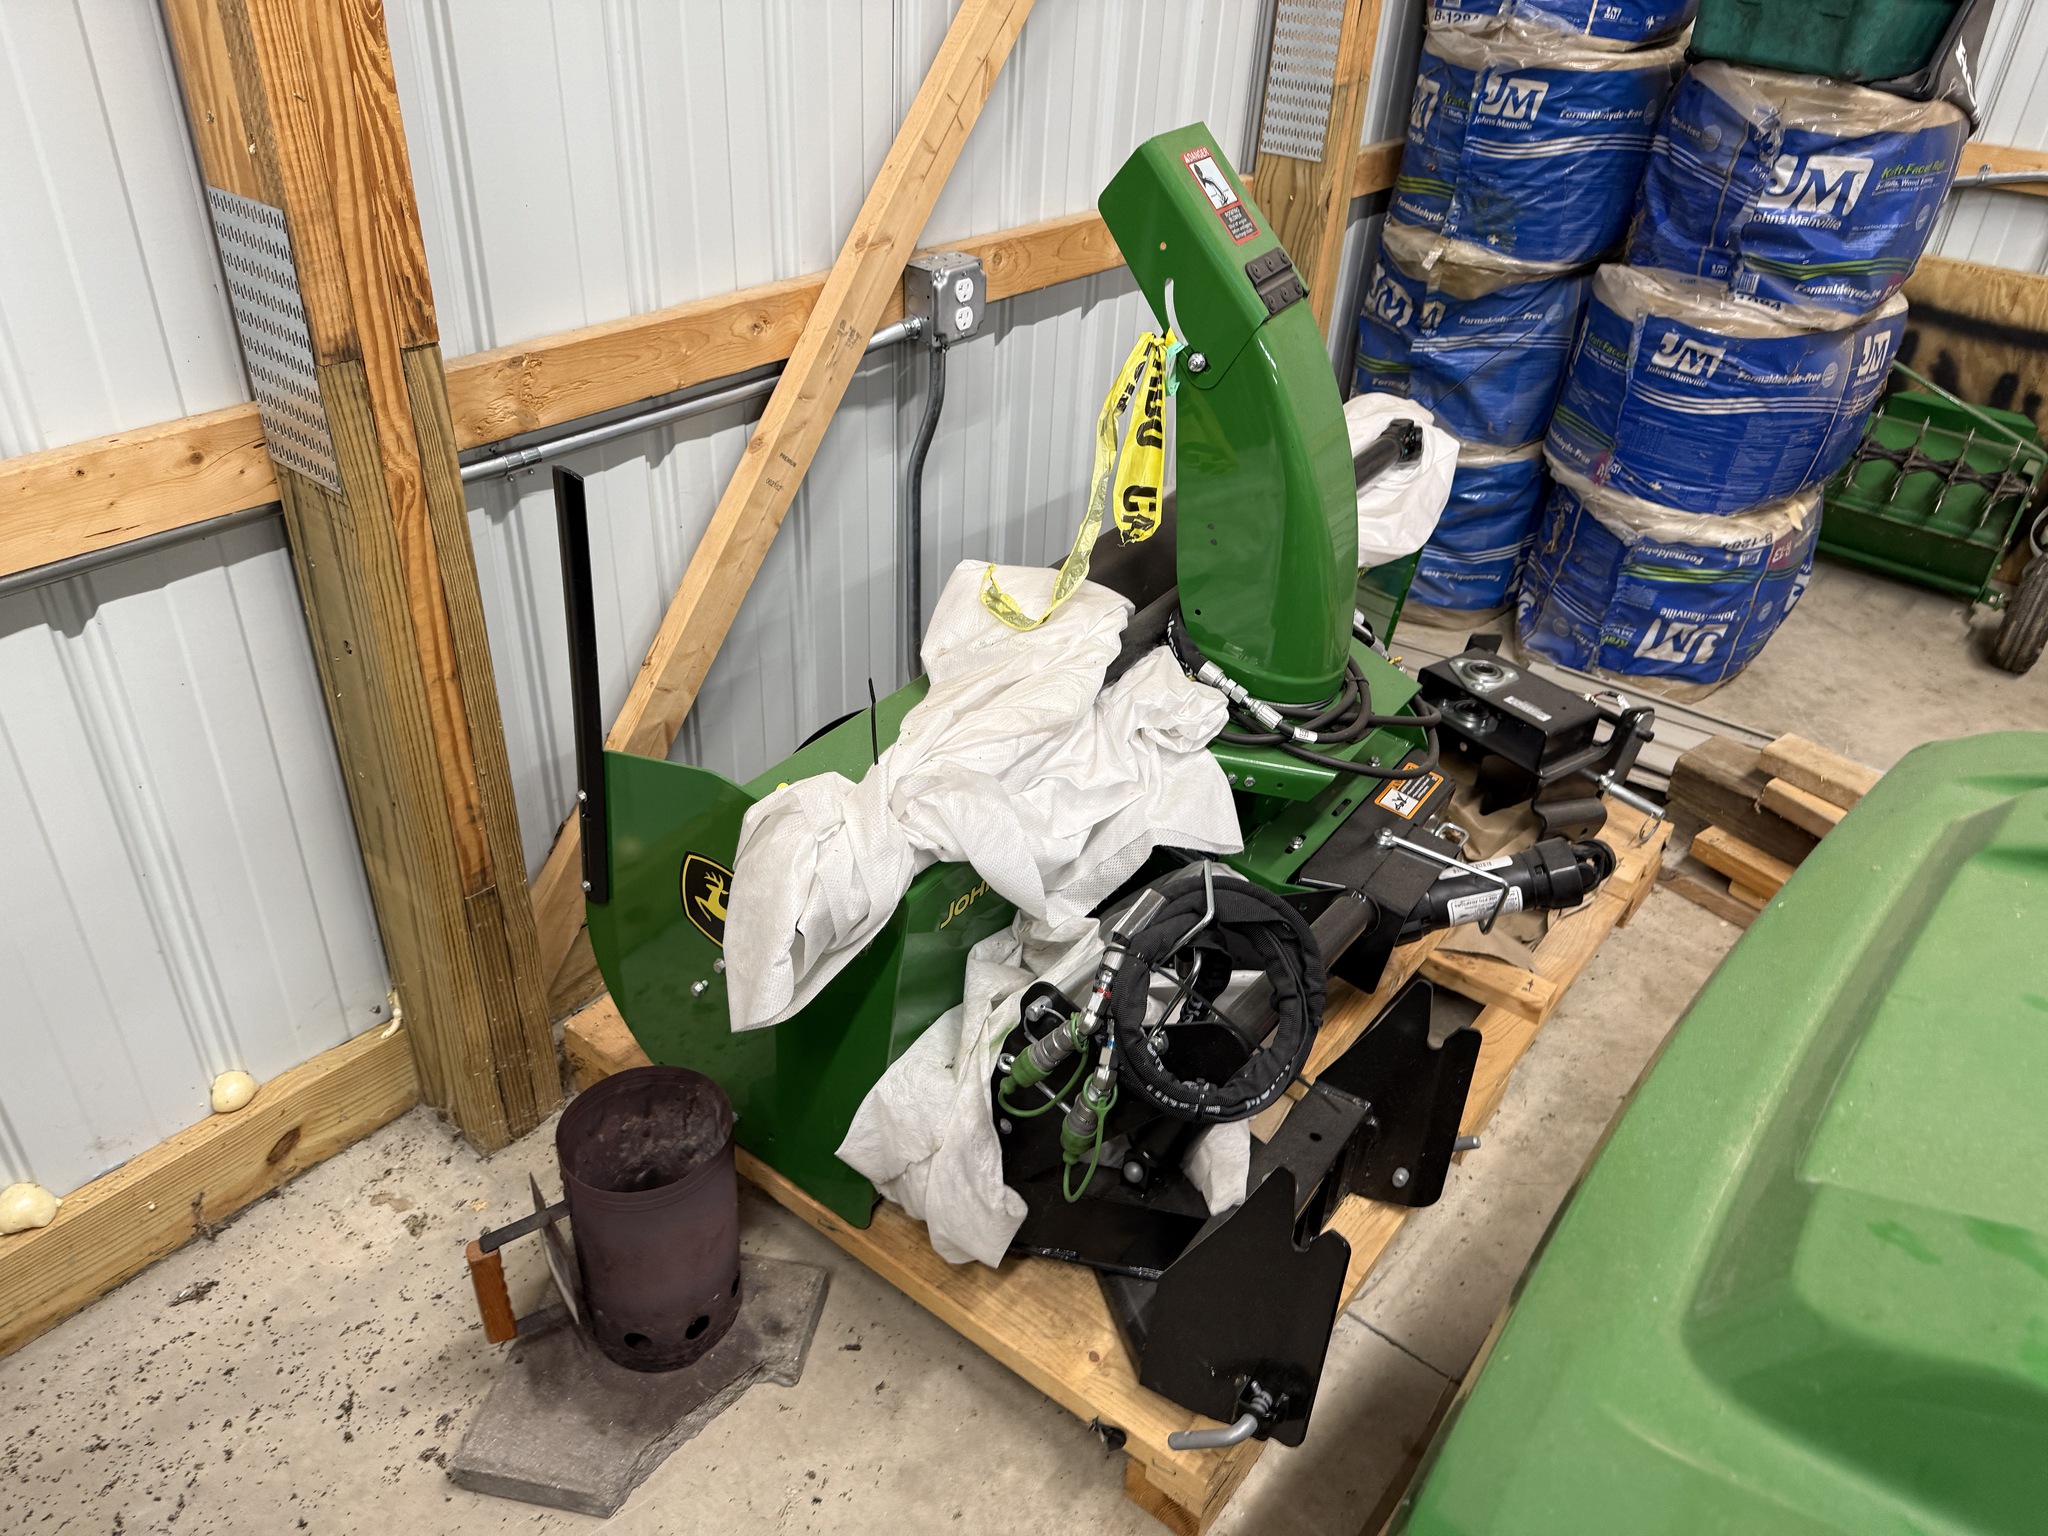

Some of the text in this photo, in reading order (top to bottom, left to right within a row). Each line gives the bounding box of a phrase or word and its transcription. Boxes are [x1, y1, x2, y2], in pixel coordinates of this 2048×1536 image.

[1471, 114, 1533, 131] Johns Manville
[1187, 147, 1210, 163] DANGER
[1756, 153, 1875, 217] JM
[1749, 210, 1788, 226] Johns
[1788, 214, 1843, 231] Manville
[1651, 331, 1727, 379] JM
[1856, 329, 1892, 377] JM
[1645, 364, 1709, 388] Johns Manville
[1771, 540, 1793, 564] R-13
[1659, 606, 1708, 622] Manville
[1633, 617, 1729, 664] JM
[939, 880, 990, 930] JOH
